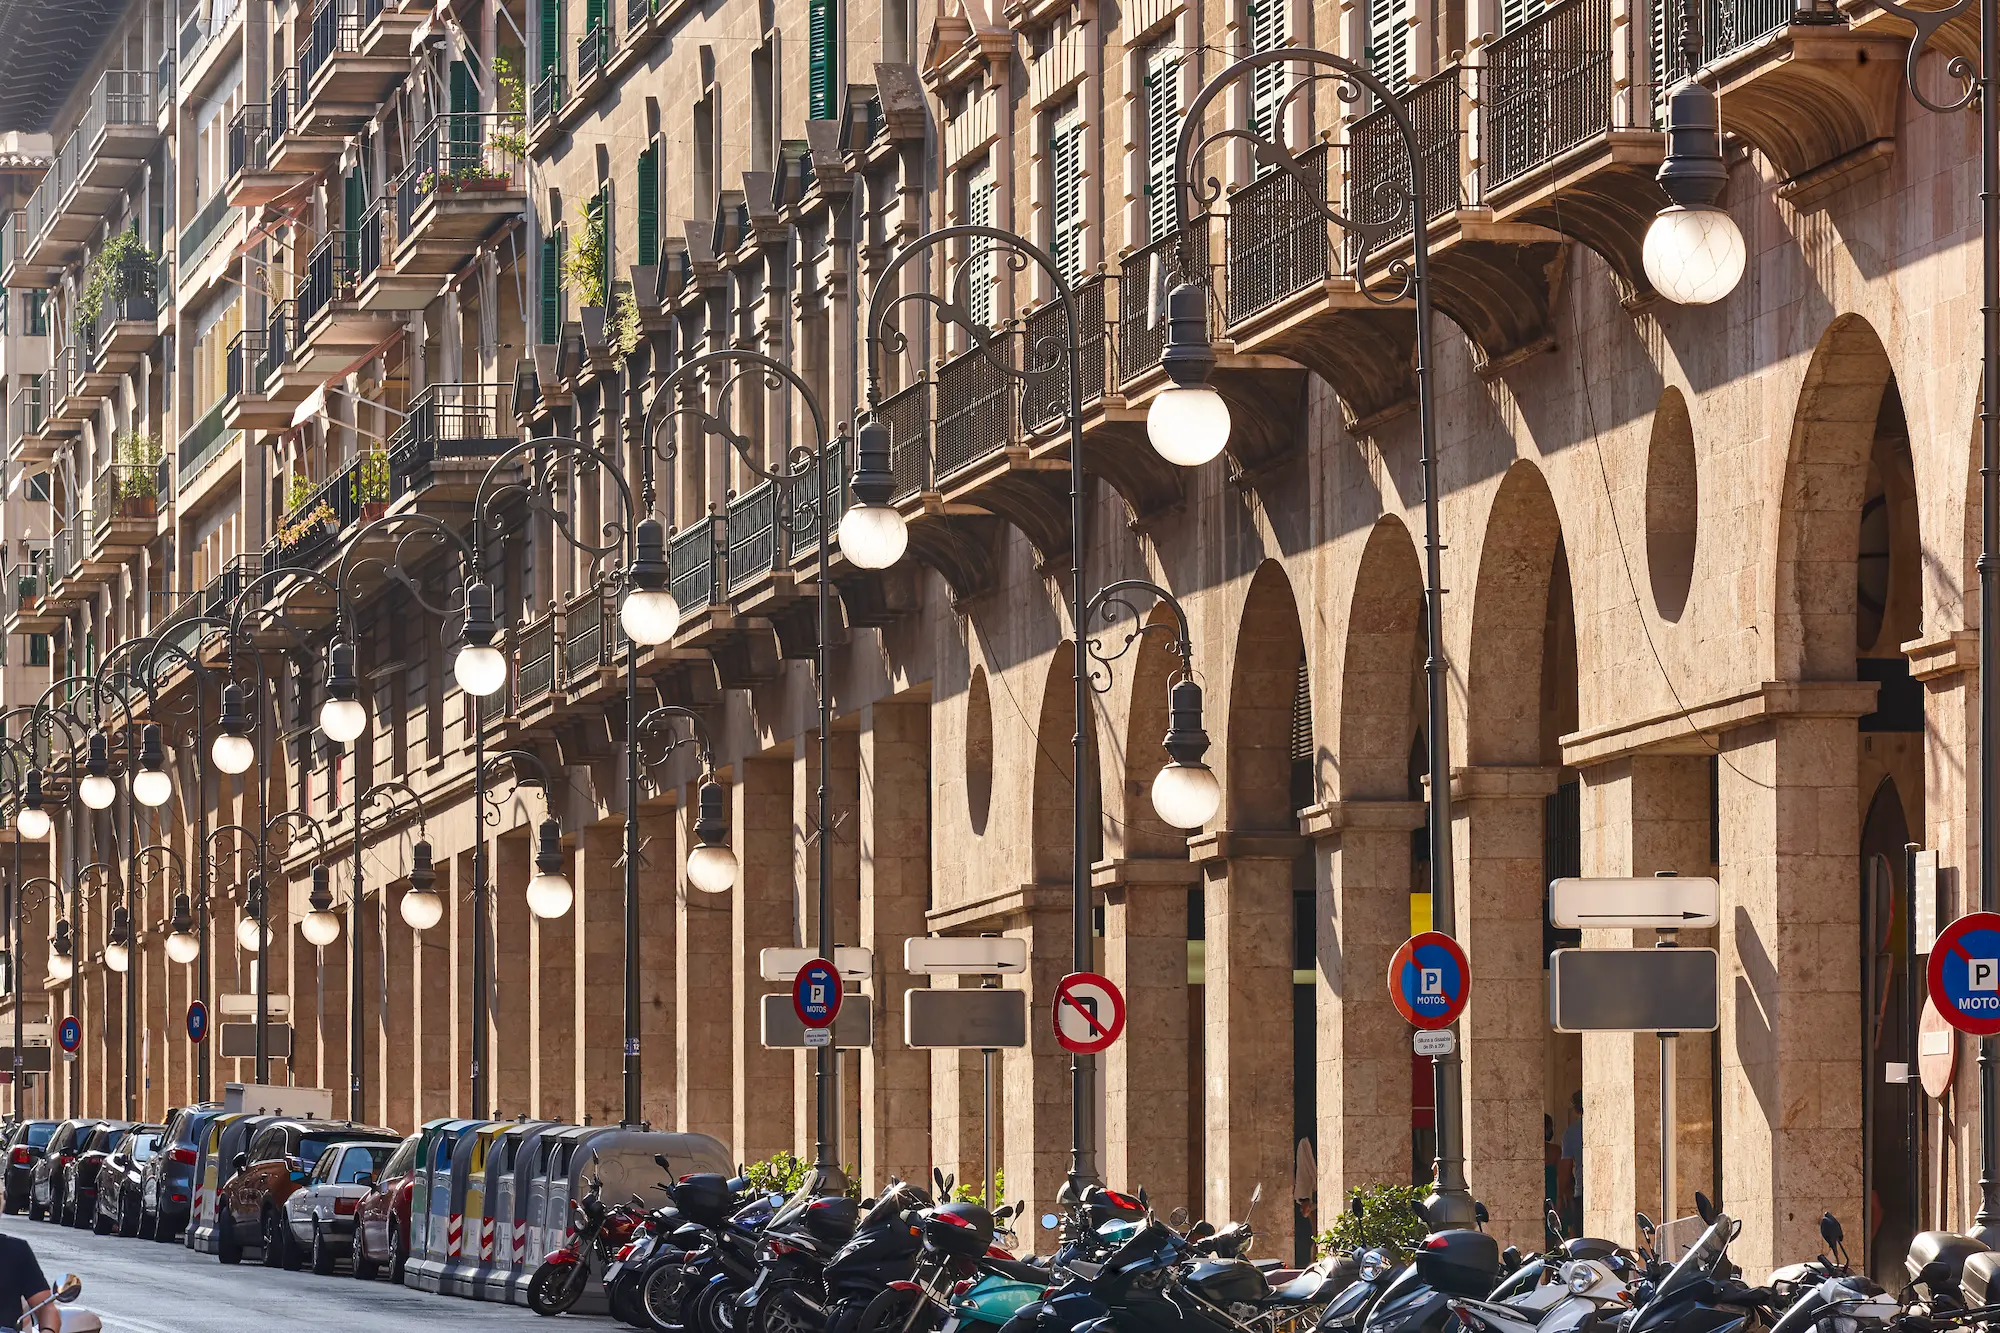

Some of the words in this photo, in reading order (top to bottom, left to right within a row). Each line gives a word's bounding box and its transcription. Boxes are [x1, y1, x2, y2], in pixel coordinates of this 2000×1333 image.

[1976, 964, 1990, 985] P
[1426, 972, 1437, 990] P
[813, 987, 820, 1000] P
[1416, 996, 1446, 1005] MOTOS
[1959, 997, 2000, 1009] MOTO
[806, 1005, 827, 1013] MOTOS
